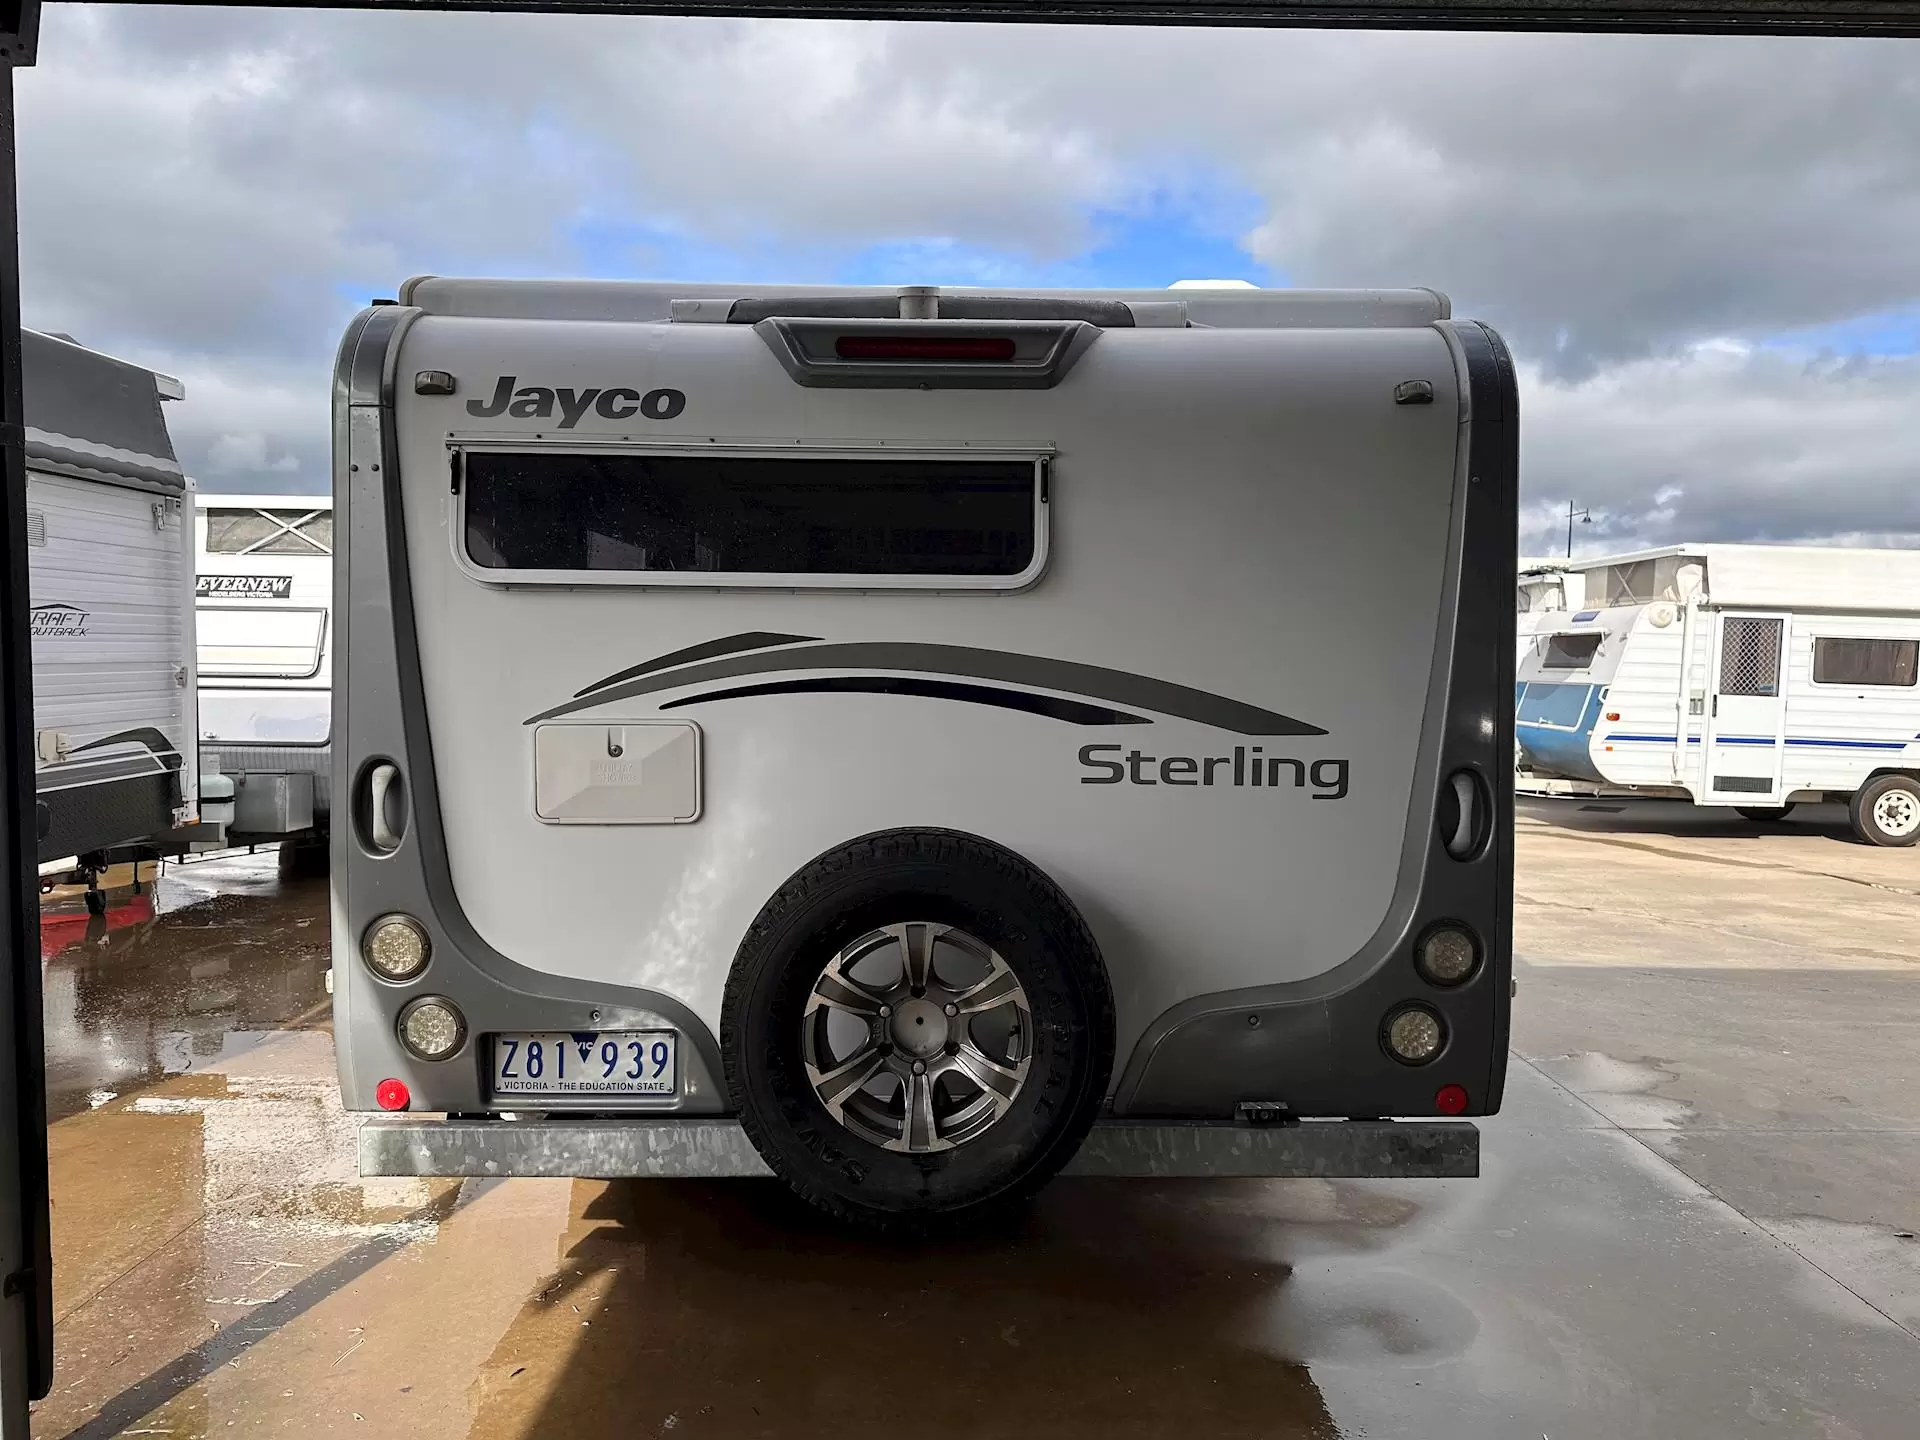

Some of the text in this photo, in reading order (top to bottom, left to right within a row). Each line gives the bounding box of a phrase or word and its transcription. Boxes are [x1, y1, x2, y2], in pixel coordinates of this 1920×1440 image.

[466, 376, 686, 429] Jayco
[196, 576, 292, 592] EVERNEW
[30, 611, 90, 626] RAFT
[1078, 744, 1350, 800] Sterling
[576, 1041, 594, 1051] VIC
[501, 1040, 668, 1079] Z81 939
[504, 1081, 549, 1091] VICTORIA
[558, 1082, 577, 1091] THE
[579, 1081, 636, 1091] EDUCATION
[636, 1082, 665, 1091] STATE
